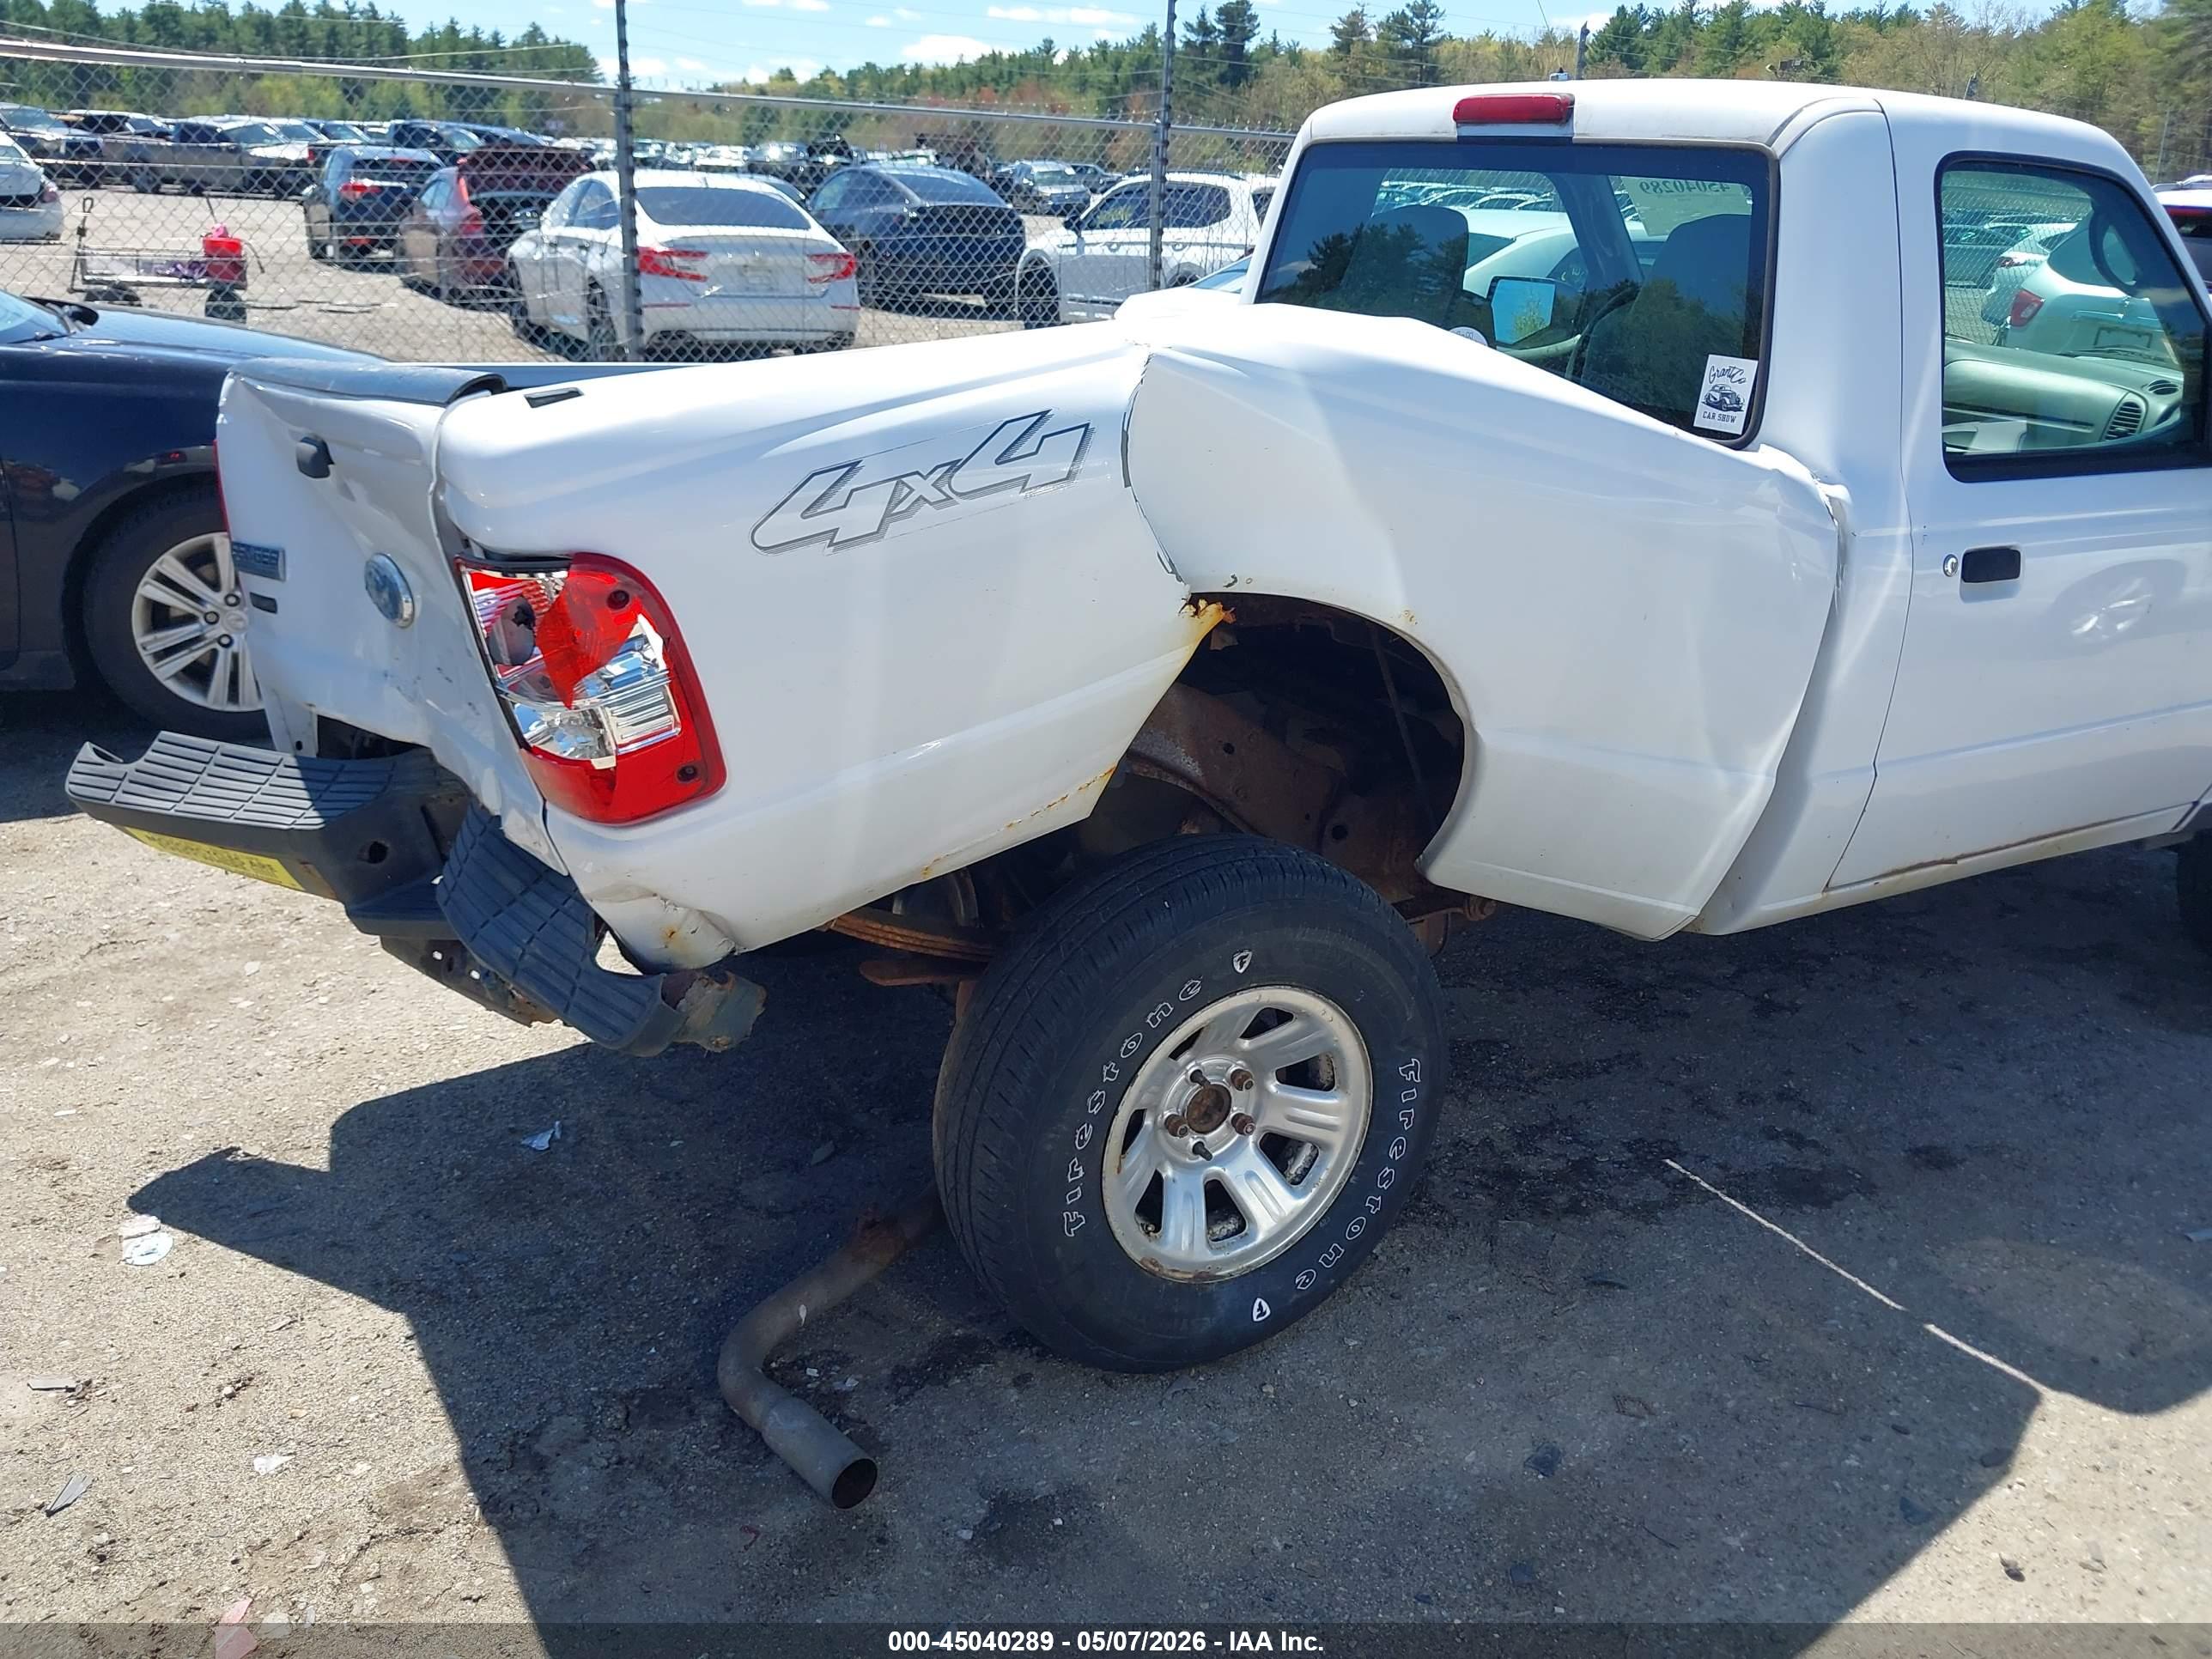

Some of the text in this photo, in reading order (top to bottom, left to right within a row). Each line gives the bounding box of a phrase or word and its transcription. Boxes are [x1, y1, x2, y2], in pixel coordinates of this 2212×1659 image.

[750, 409, 1095, 555] 4x4
[1703, 410, 1717, 420] CAR
[1064, 976, 1204, 1237] Firestone
[1295, 1058, 1421, 1290] Firestone
